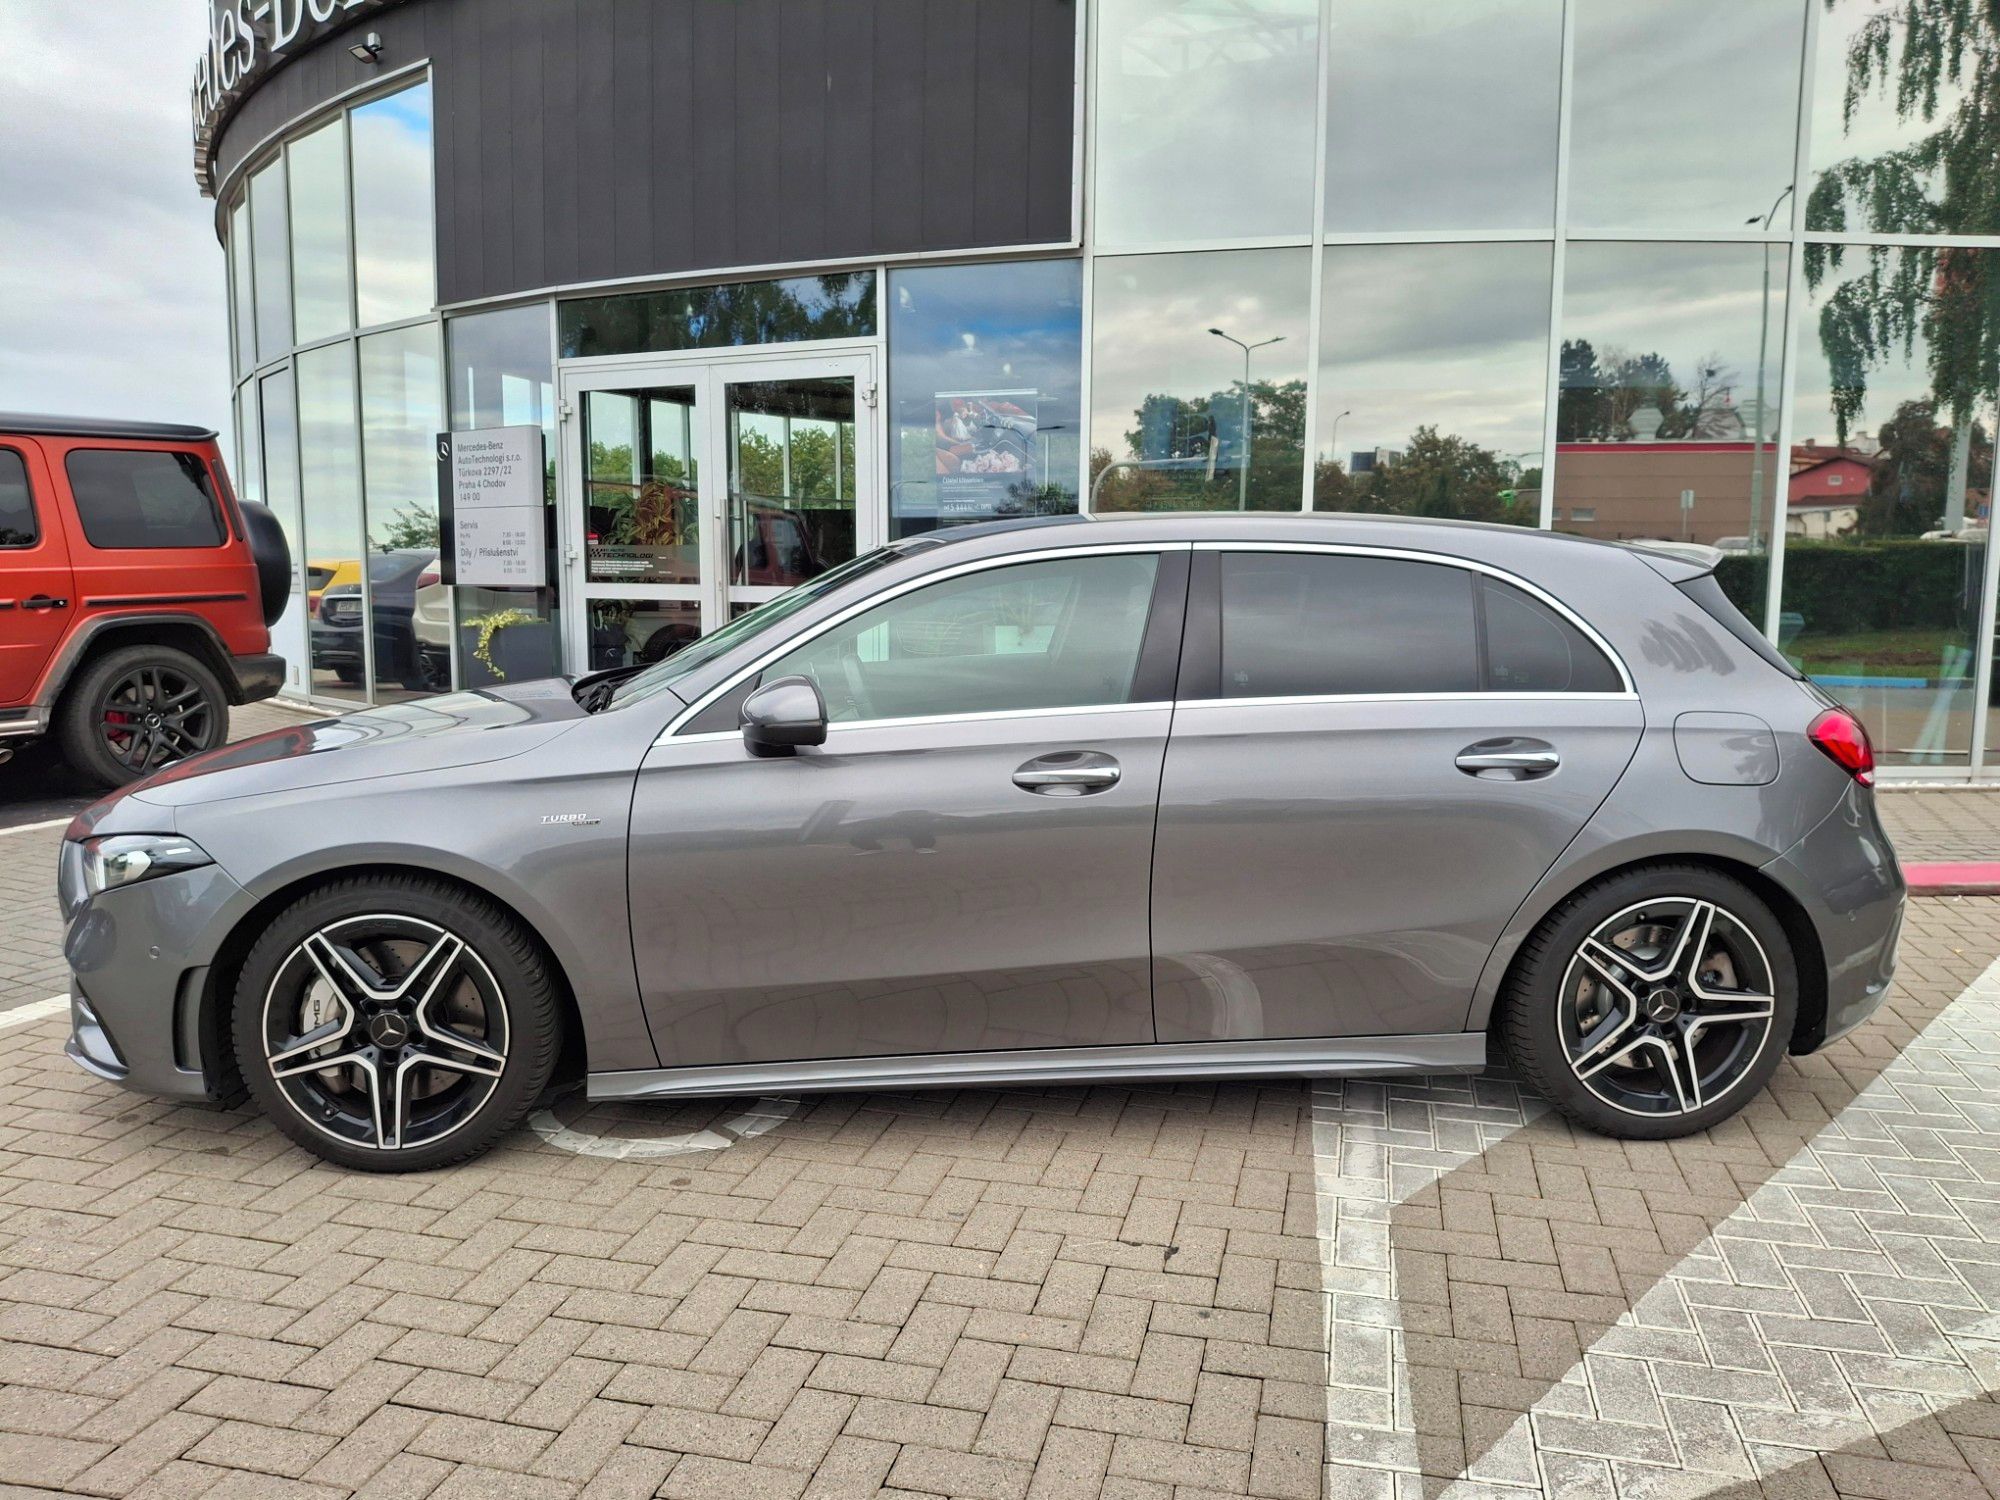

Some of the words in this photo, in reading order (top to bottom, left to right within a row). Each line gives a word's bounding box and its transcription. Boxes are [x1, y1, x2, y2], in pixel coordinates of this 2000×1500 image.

[457, 441, 504, 452] Mercedes-Benz
[457, 453, 505, 464] AutoTechnologi
[506, 454, 522, 462] s.r.o.
[458, 480, 476, 489] Praha
[477, 480, 482, 488] 4
[482, 479, 506, 488] Chodov
[459, 520, 478, 529] Servis
[460, 547, 472, 558] Díly
[479, 547, 519, 557] Příslušenství
[540, 813, 587, 825] TURBO
[313, 999, 321, 1027] MG
